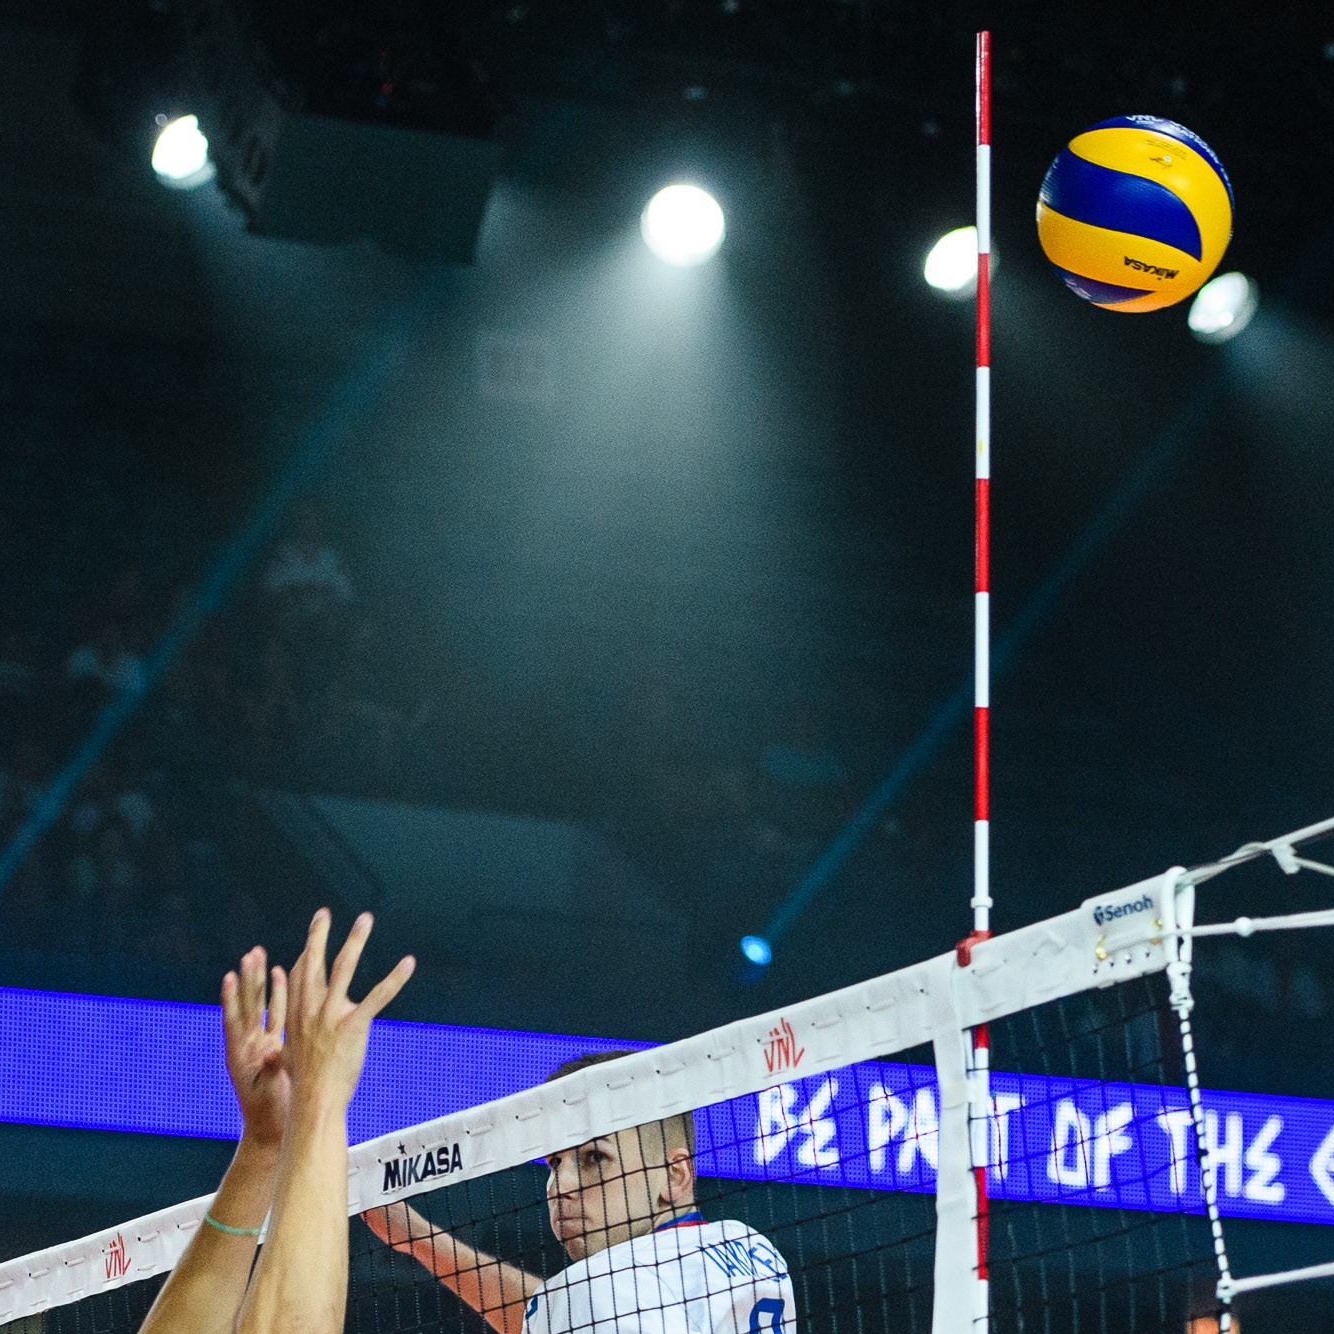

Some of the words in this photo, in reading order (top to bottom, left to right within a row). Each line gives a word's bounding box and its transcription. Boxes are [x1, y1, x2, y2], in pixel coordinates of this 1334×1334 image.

[1124, 256, 1179, 279] MIKASA
[1105, 895, 1154, 921] Senoh
[754, 1078, 840, 1167] BE
[867, 1081, 1023, 1182] PAT
[1047, 1099, 1133, 1193] OF
[1158, 1102, 1285, 1202] THE
[383, 1142, 464, 1192] MIKASA
